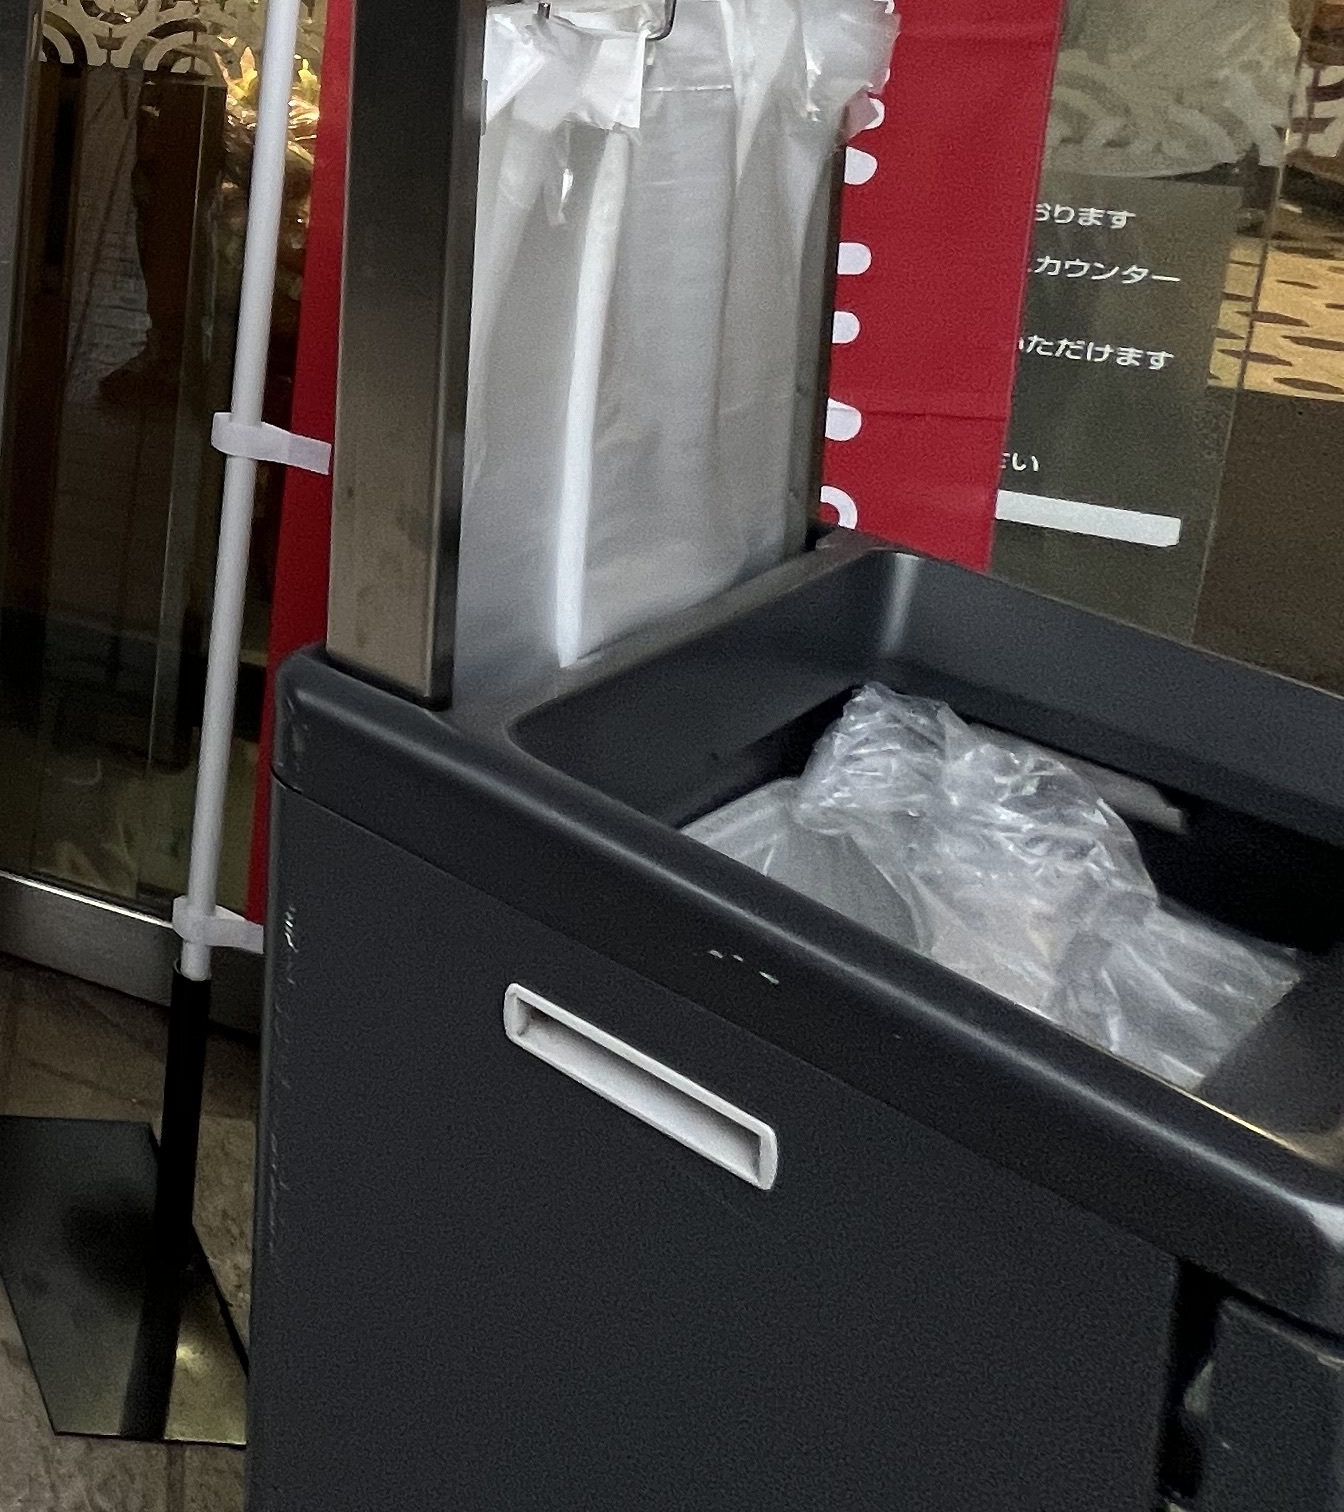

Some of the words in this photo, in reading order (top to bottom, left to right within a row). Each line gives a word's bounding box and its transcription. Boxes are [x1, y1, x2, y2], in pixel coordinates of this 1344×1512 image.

[1027, 255, 1181, 284] カウンター
